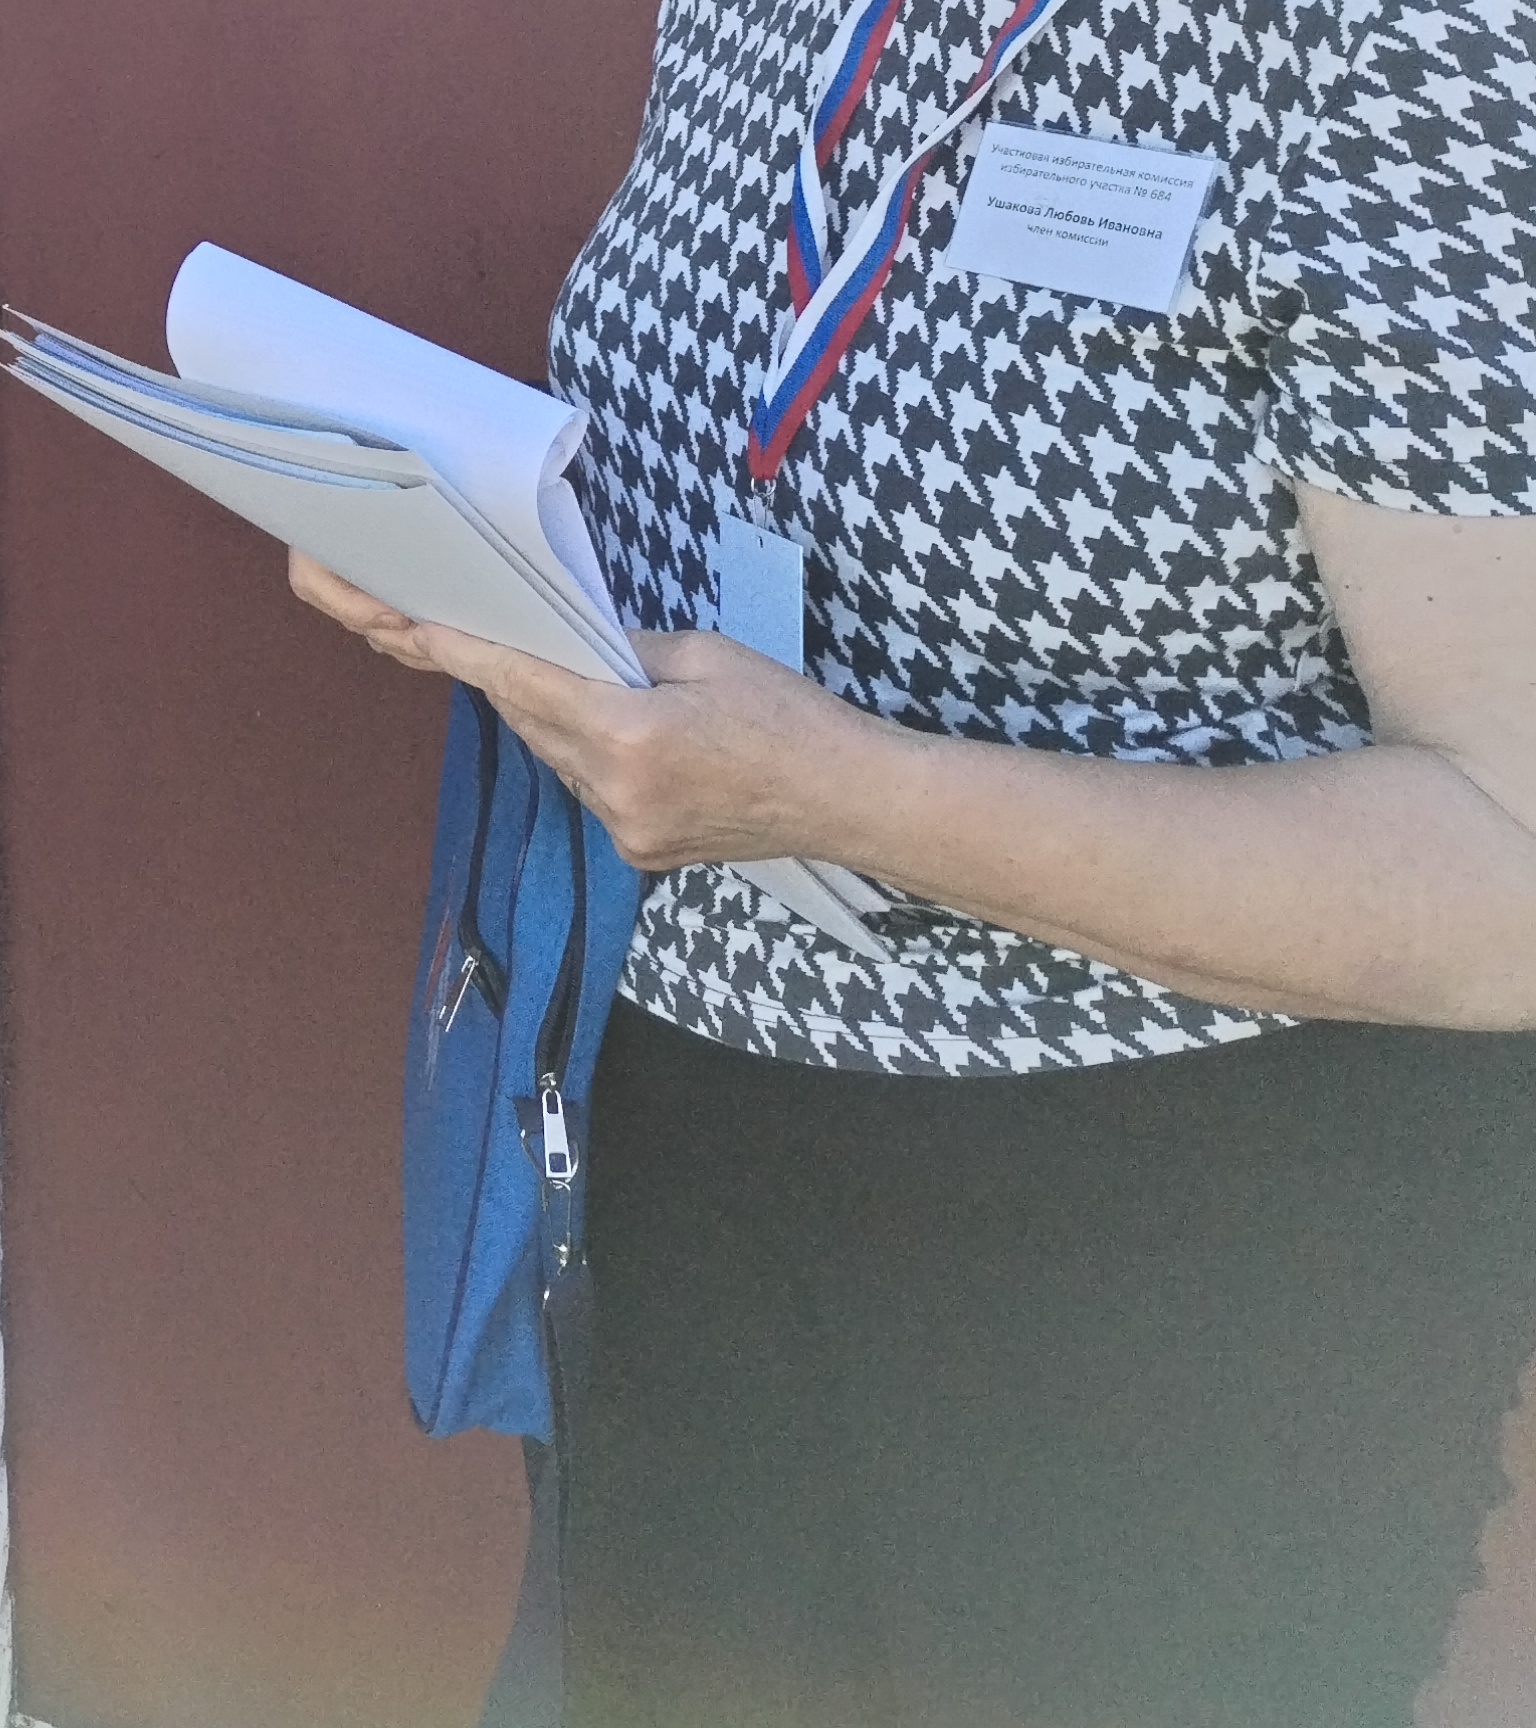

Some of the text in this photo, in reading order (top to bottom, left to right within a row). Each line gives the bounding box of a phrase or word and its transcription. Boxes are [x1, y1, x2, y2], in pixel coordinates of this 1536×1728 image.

[1000, 164, 1087, 186] избирательного
[1089, 180, 1131, 195] участка
[1051, 156, 1136, 178] избирательная
[1137, 172, 1194, 188] комиссия
[987, 196, 1163, 240] Ушакова Любовь Ивановна
[1027, 224, 1109, 247] член комиссии
